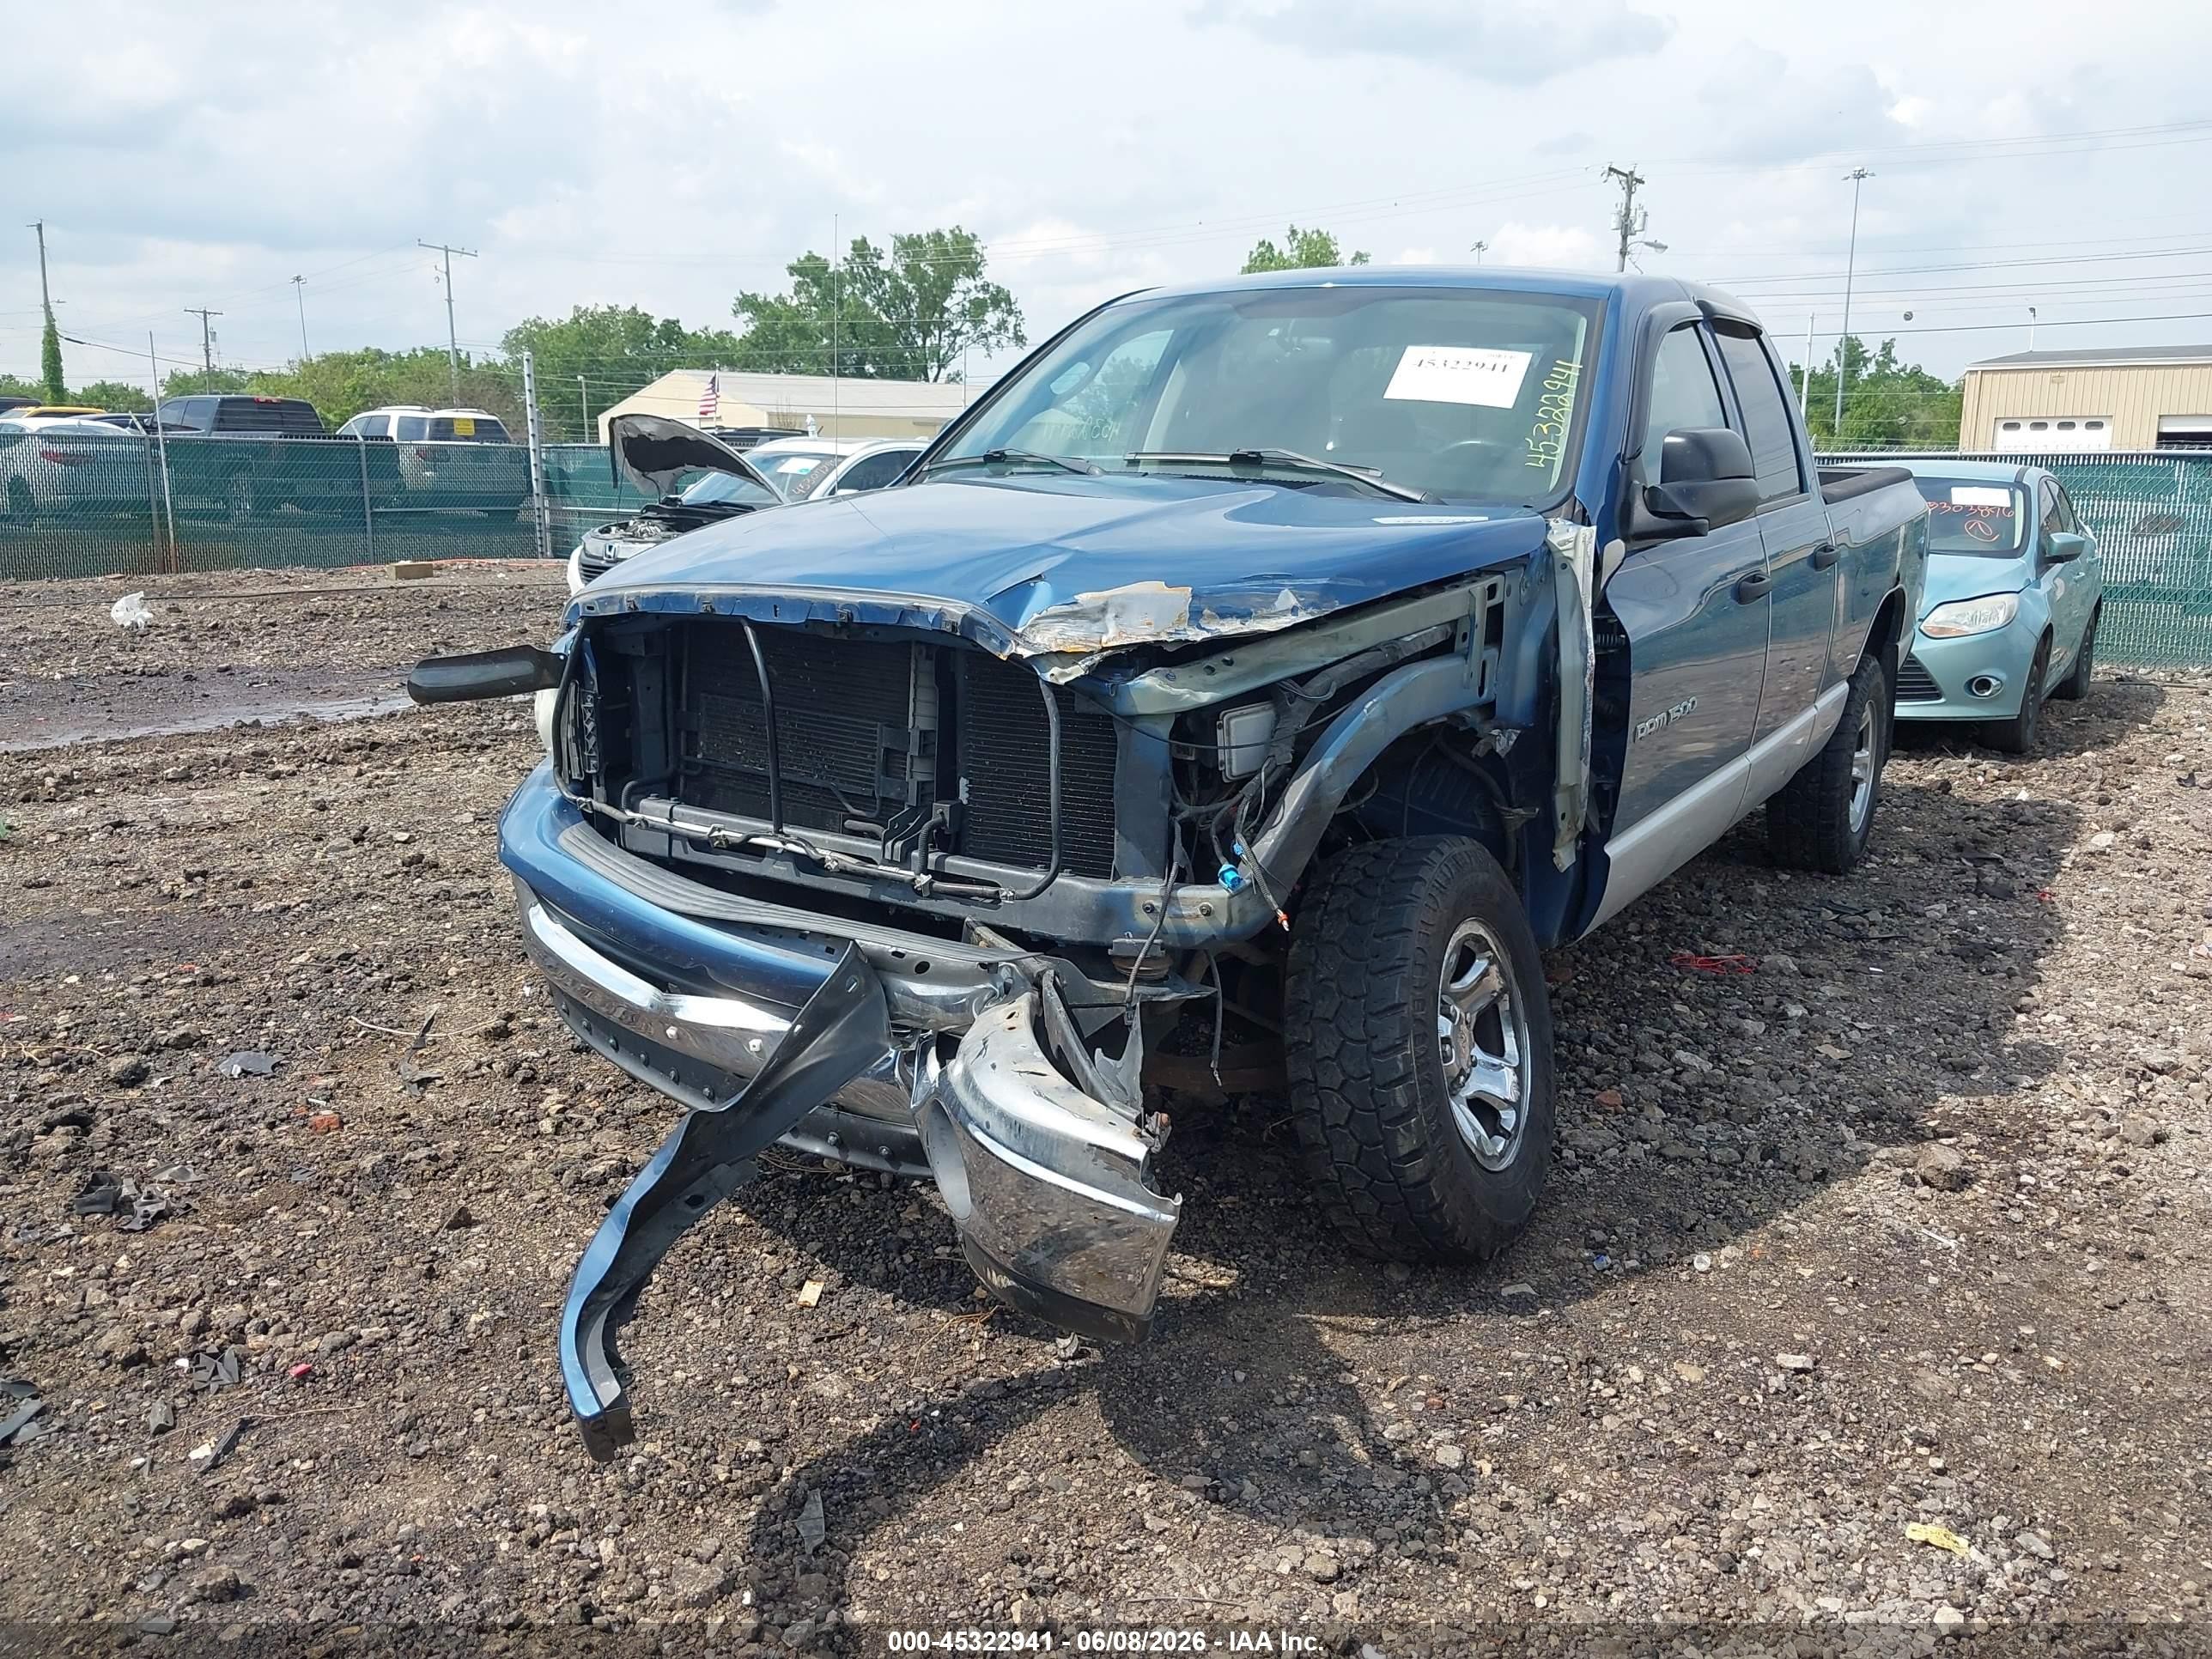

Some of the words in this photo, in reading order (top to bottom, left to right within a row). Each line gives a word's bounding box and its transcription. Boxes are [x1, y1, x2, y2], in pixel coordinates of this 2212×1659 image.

[1413, 359, 1508, 373] 45322941
[1525, 360, 1583, 467] 45322941
[1668, 697, 1698, 722] 1500
